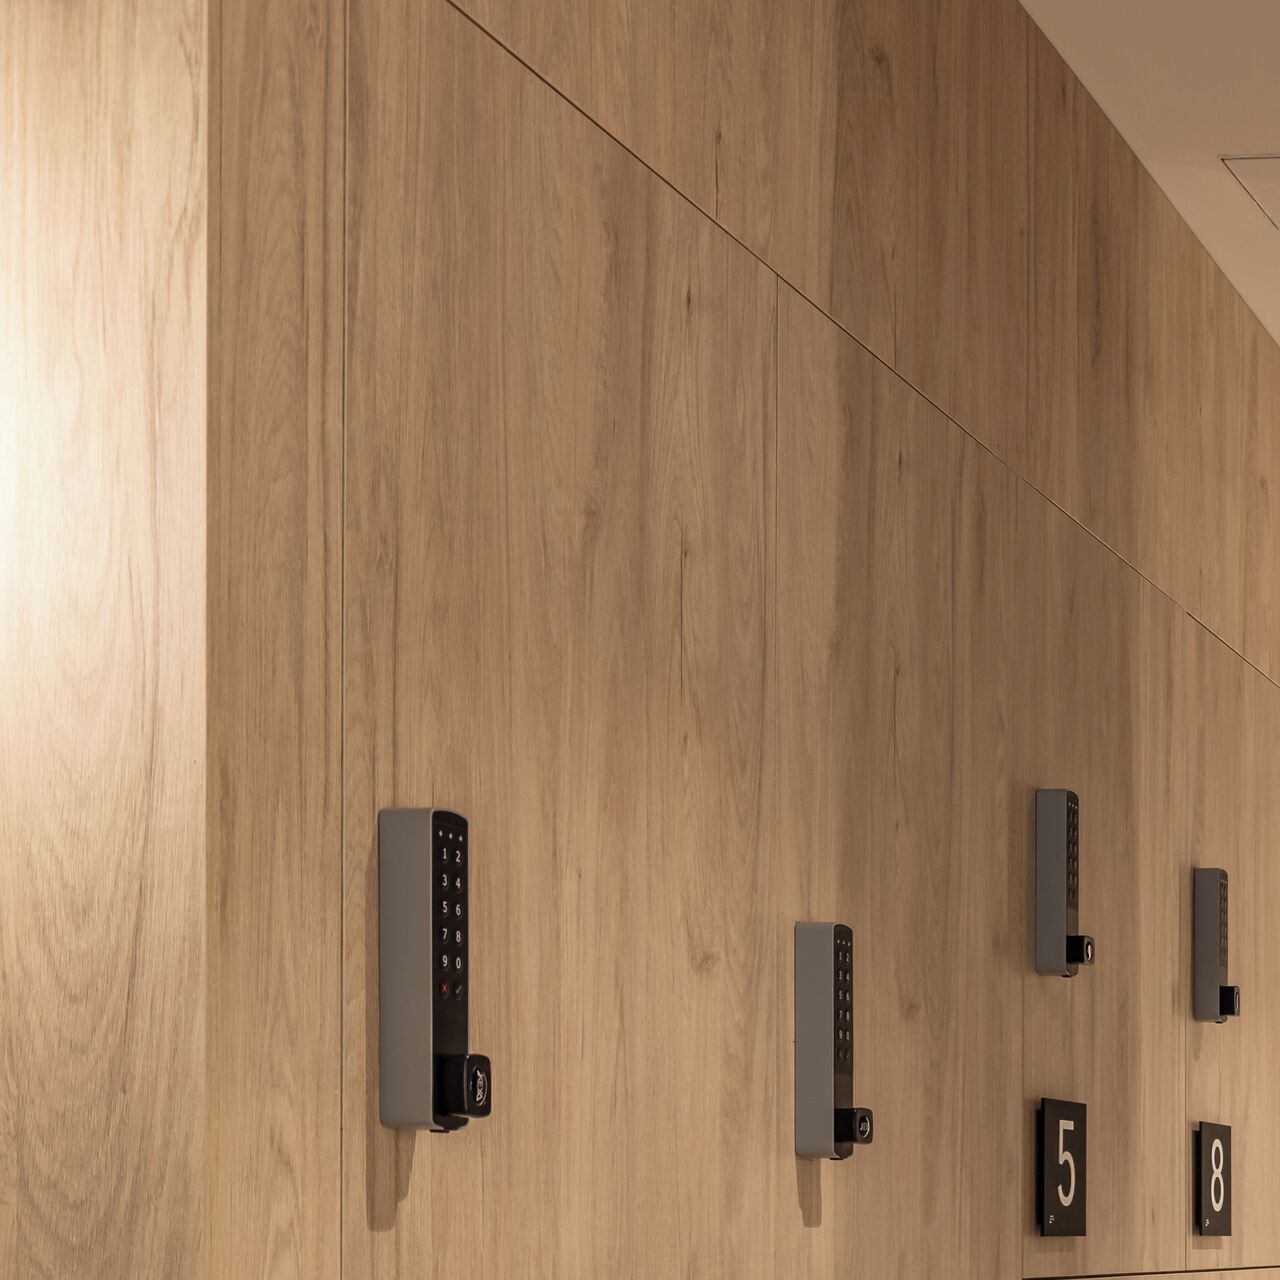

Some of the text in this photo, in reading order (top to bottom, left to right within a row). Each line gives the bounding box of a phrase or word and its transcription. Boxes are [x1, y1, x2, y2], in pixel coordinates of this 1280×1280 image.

[456, 851, 461, 862] 2
[442, 874, 461, 889] 3 4
[443, 901, 461, 916] 5 6
[442, 928, 461, 942] 7 8
[443, 955, 448, 967] 9
[1057, 1119, 1076, 1207] 5
[1210, 1138, 1225, 1213] 8
